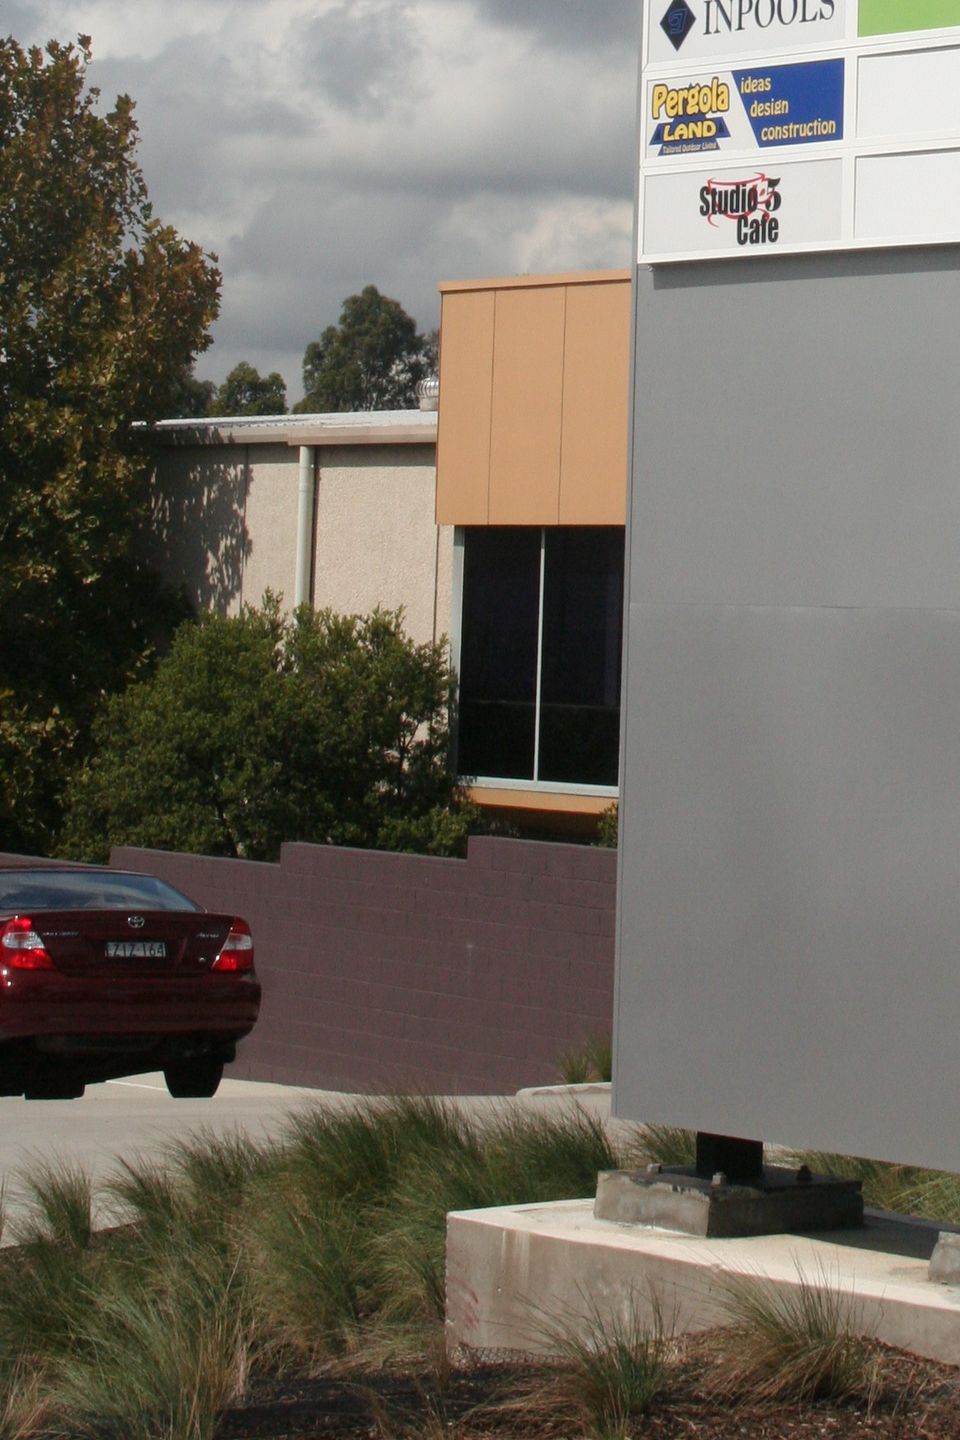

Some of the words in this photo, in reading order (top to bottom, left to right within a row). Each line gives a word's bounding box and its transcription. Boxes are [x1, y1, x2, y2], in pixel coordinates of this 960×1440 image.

[740, 76, 772, 94] ideas
[652, 76, 730, 119] Pergola
[750, 98, 789, 117] design
[663, 119, 717, 142] LAND
[761, 118, 836, 141] construction
[699, 183, 758, 217] Studio
